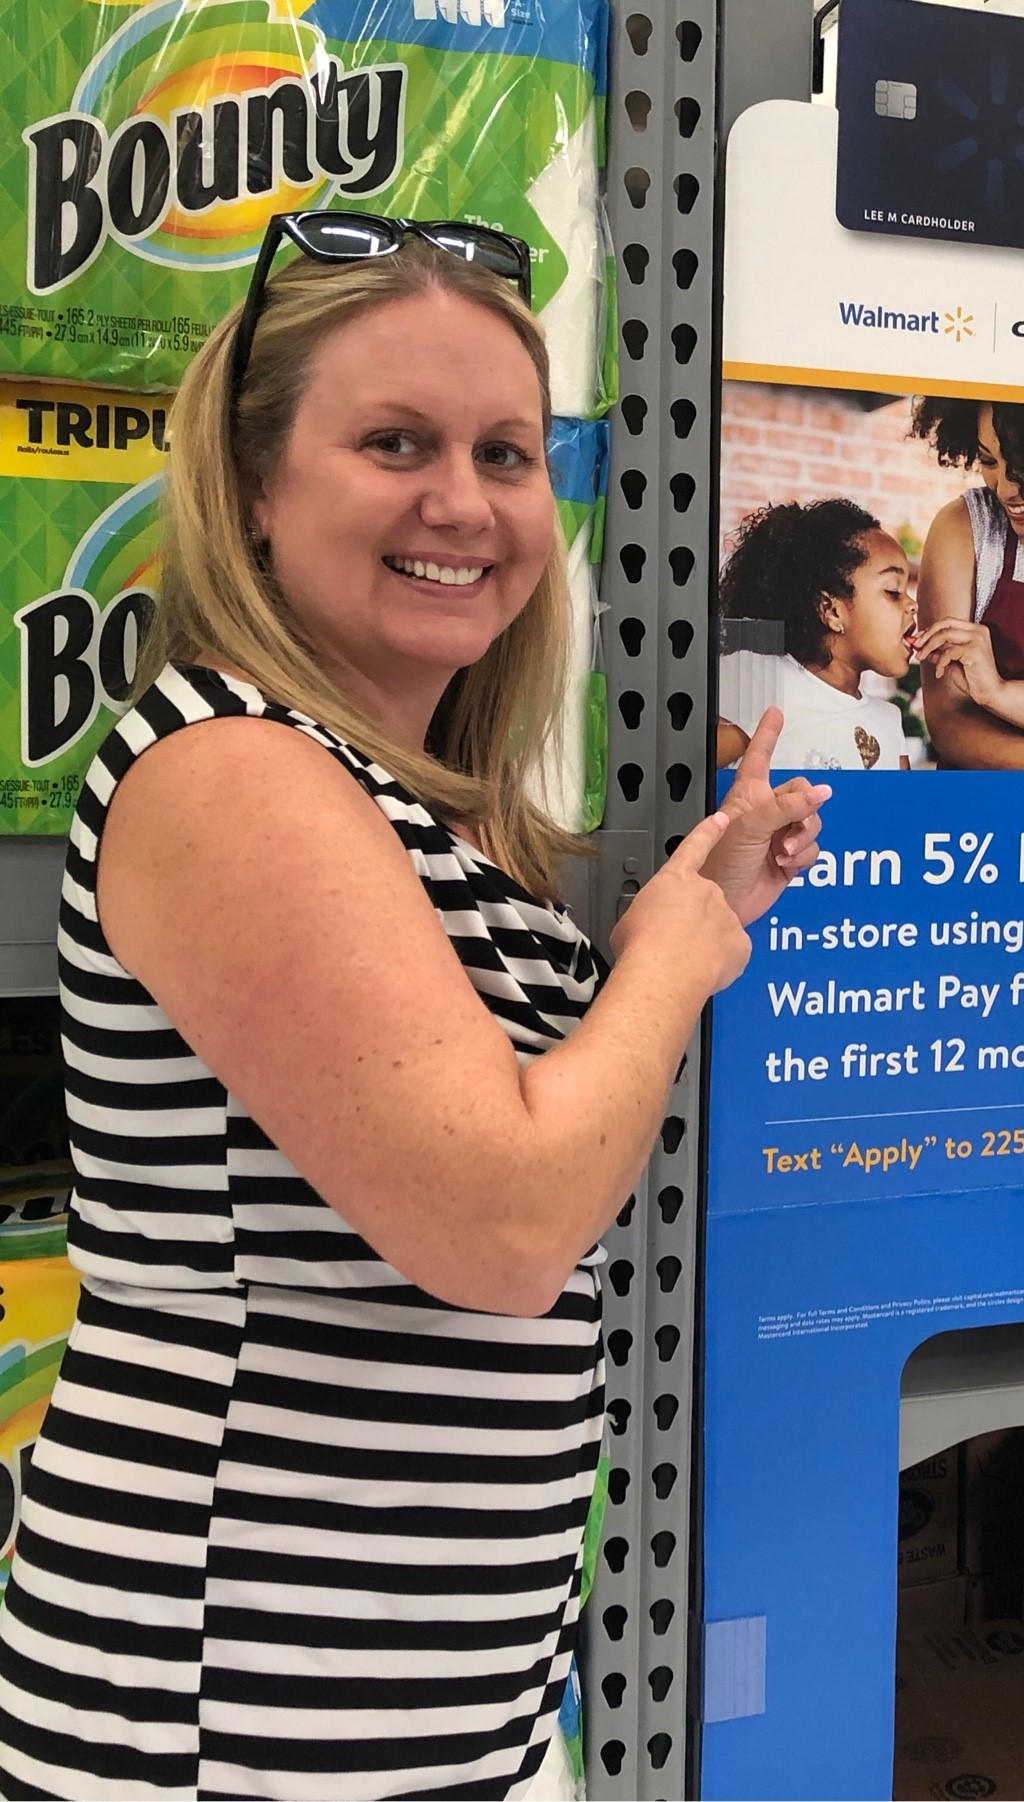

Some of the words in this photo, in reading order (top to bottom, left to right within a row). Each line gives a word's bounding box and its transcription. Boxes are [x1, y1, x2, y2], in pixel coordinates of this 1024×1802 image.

[511, 8, 531, 18] Size
[26, 62, 404, 292] Bounty
[864, 209, 884, 223] LEE
[888, 211, 897, 224] M
[900, 213, 975, 232] CARDHOLDER
[67, 307, 84, 325] 165
[111, 316, 136, 329] SHEETS
[137, 319, 150, 332] PER
[839, 302, 940, 334] Walmart
[17, 446, 70, 456] Rolls/rouleaux
[61, 775, 79, 791] 165
[923, 832, 999, 885] 5%
[769, 916, 918, 951] in-store
[930, 911, 1024, 952] using
[768, 980, 925, 1017] Walmart
[939, 976, 1000, 1017] Pay
[765, 1049, 828, 1083] the
[841, 1043, 918, 1079] first
[930, 1038, 965, 1073] 12
[762, 1147, 821, 1174] Text
[945, 1135, 972, 1159] to
[758, 1314, 776, 1323] Terms
[796, 1311, 807, 1319] For
[808, 1309, 818, 1317] full
[819, 1307, 836, 1316] Terms
[837, 1306, 848, 1315] and
[849, 1304, 880, 1313] Conditions
[880, 1301, 891, 1310] and
[892, 1300, 913, 1309] Privacy
[933, 1296, 951, 1306] please
[952, 1294, 963, 1302] visit
[758, 1322, 788, 1332] messaging
[790, 1320, 801, 1328] and
[802, 1318, 814, 1327] data
[816, 1317, 831, 1325] rates
[832, 1316, 843, 1325] may
[862, 1310, 894, 1320] Mastercard
[905, 1305, 934, 1315] registered
[966, 1300, 976, 1309] and
[977, 1299, 987, 1307] the
[988, 1298, 1006, 1307] circles
[1007, 1296, 1024, 1306] design
[758, 1330, 792, 1340] Mastercard
[793, 1326, 830, 1336] International
